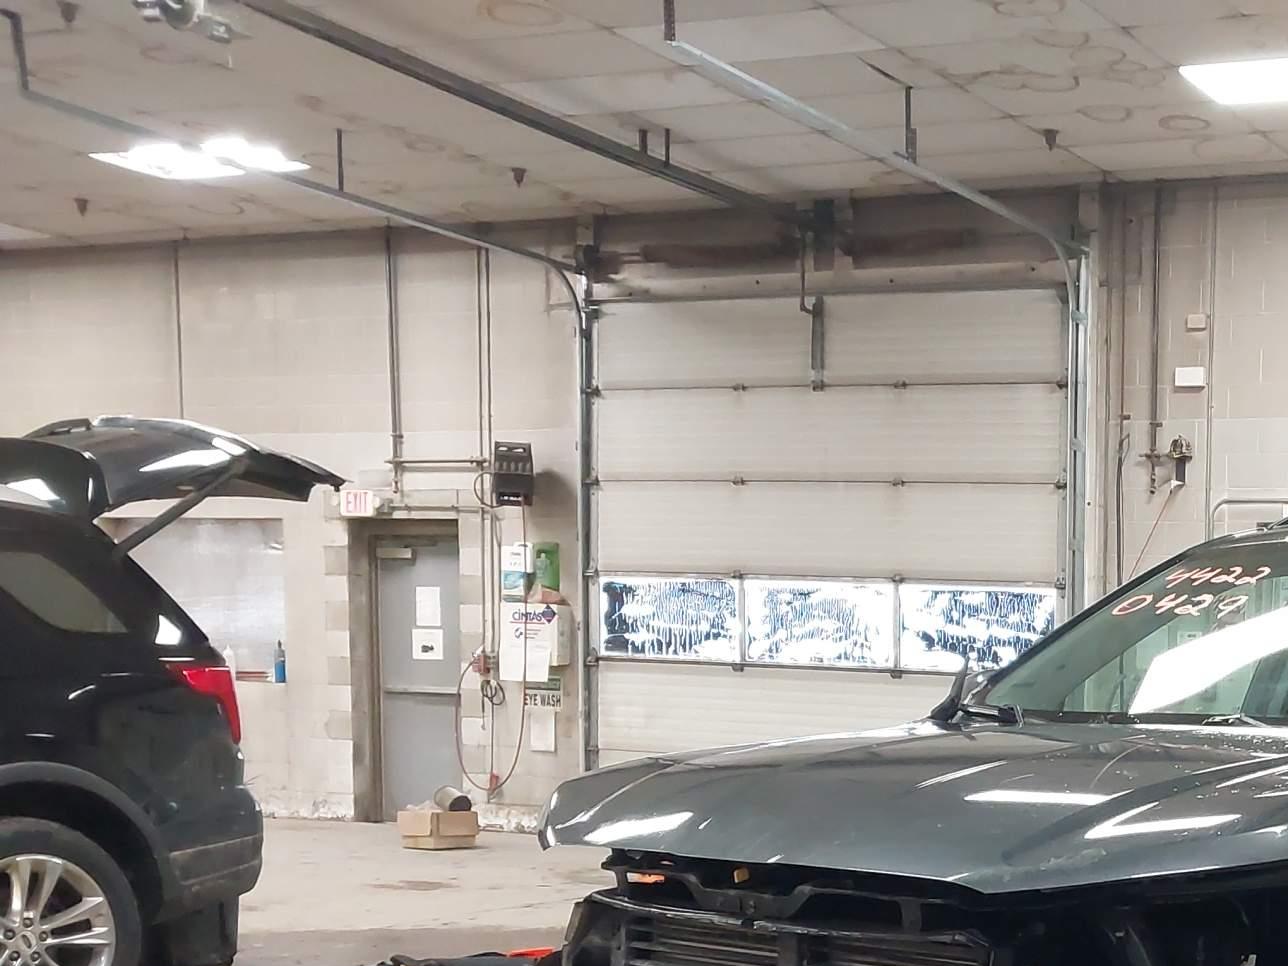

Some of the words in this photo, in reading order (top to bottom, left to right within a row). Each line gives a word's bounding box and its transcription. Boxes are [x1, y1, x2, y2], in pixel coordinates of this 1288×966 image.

[346, 492, 368, 513] EXIT
[1166, 566, 1272, 589] 4422
[1111, 593, 1249, 619] 0429
[524, 693, 538, 706] EYE
[540, 694, 561, 708] WASH
